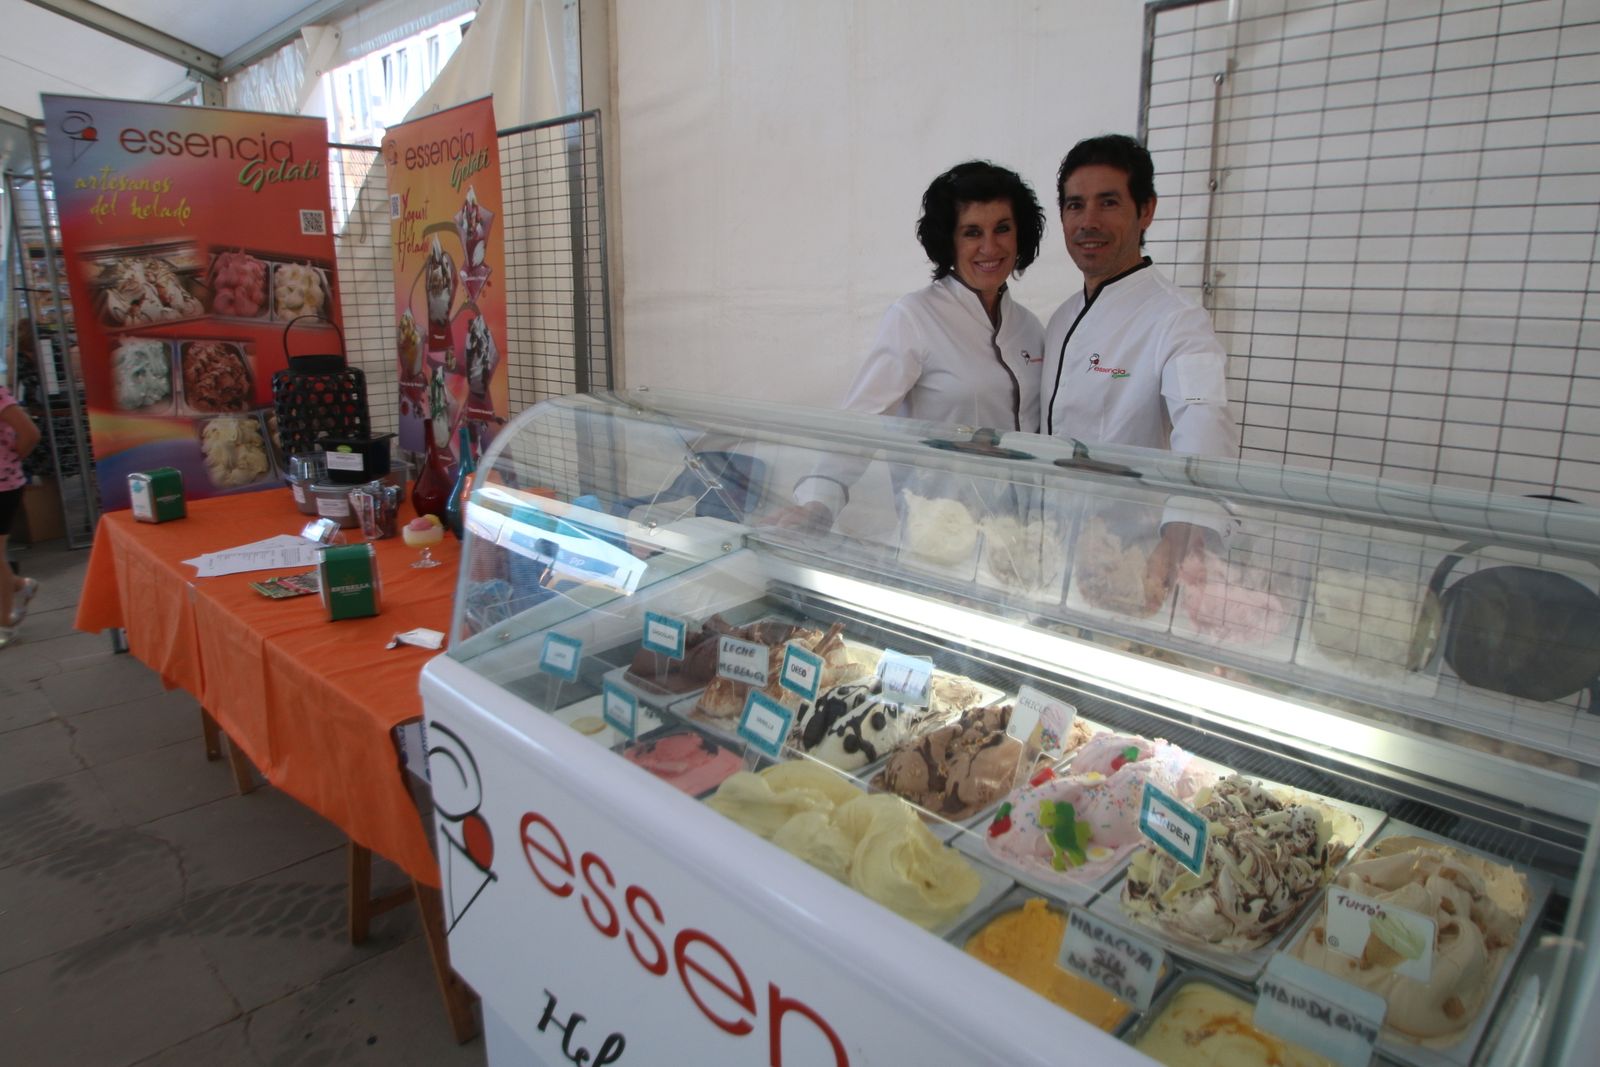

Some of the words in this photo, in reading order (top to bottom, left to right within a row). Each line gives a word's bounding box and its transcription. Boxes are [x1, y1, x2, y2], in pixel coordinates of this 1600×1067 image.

[119, 127, 294, 163] essencia
[405, 128, 475, 170] essencia
[75, 165, 172, 193] artesanos
[237, 158, 321, 193] Gelati
[451, 147, 490, 193] Gelati
[90, 191, 118, 225] del
[131, 194, 192, 227] helado
[519, 811, 850, 1067] essen
